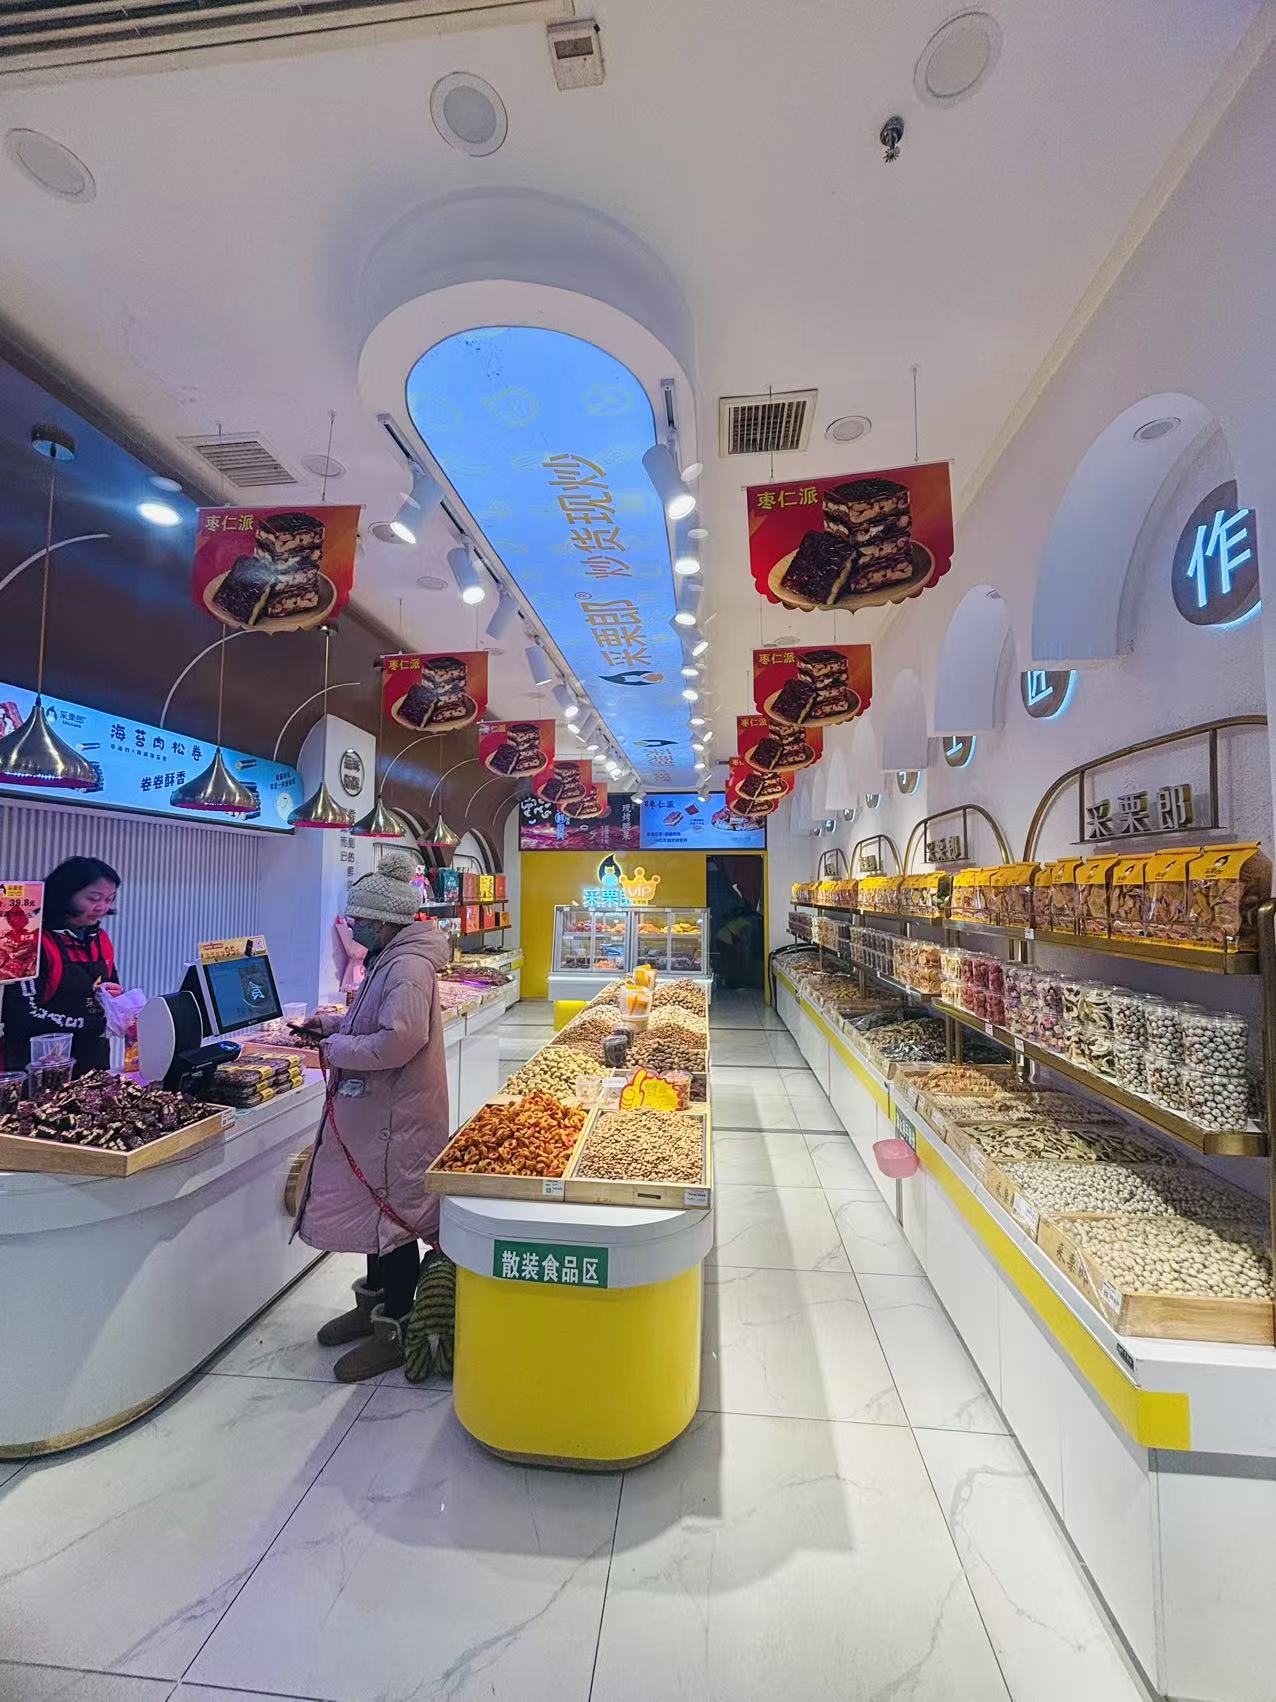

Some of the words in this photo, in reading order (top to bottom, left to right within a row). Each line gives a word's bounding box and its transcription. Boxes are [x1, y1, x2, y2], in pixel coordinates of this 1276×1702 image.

[757, 486, 818, 511] 枣仁派
[205, 514, 254, 532] 枣仁派
[542, 453, 632, 579] 炒货现炒
[1186, 508, 1252, 608] 作
[388, 658, 421, 671] 枣仁派
[759, 652, 796, 664] 枣仁派
[110, 723, 203, 762] 海苔肉松卷
[140, 770, 186, 792] 卷卷酥香
[1086, 783, 1195, 839] 采栗郎
[627, 884, 652, 897] VIP
[501, 1249, 600, 1285] 散装食品区
